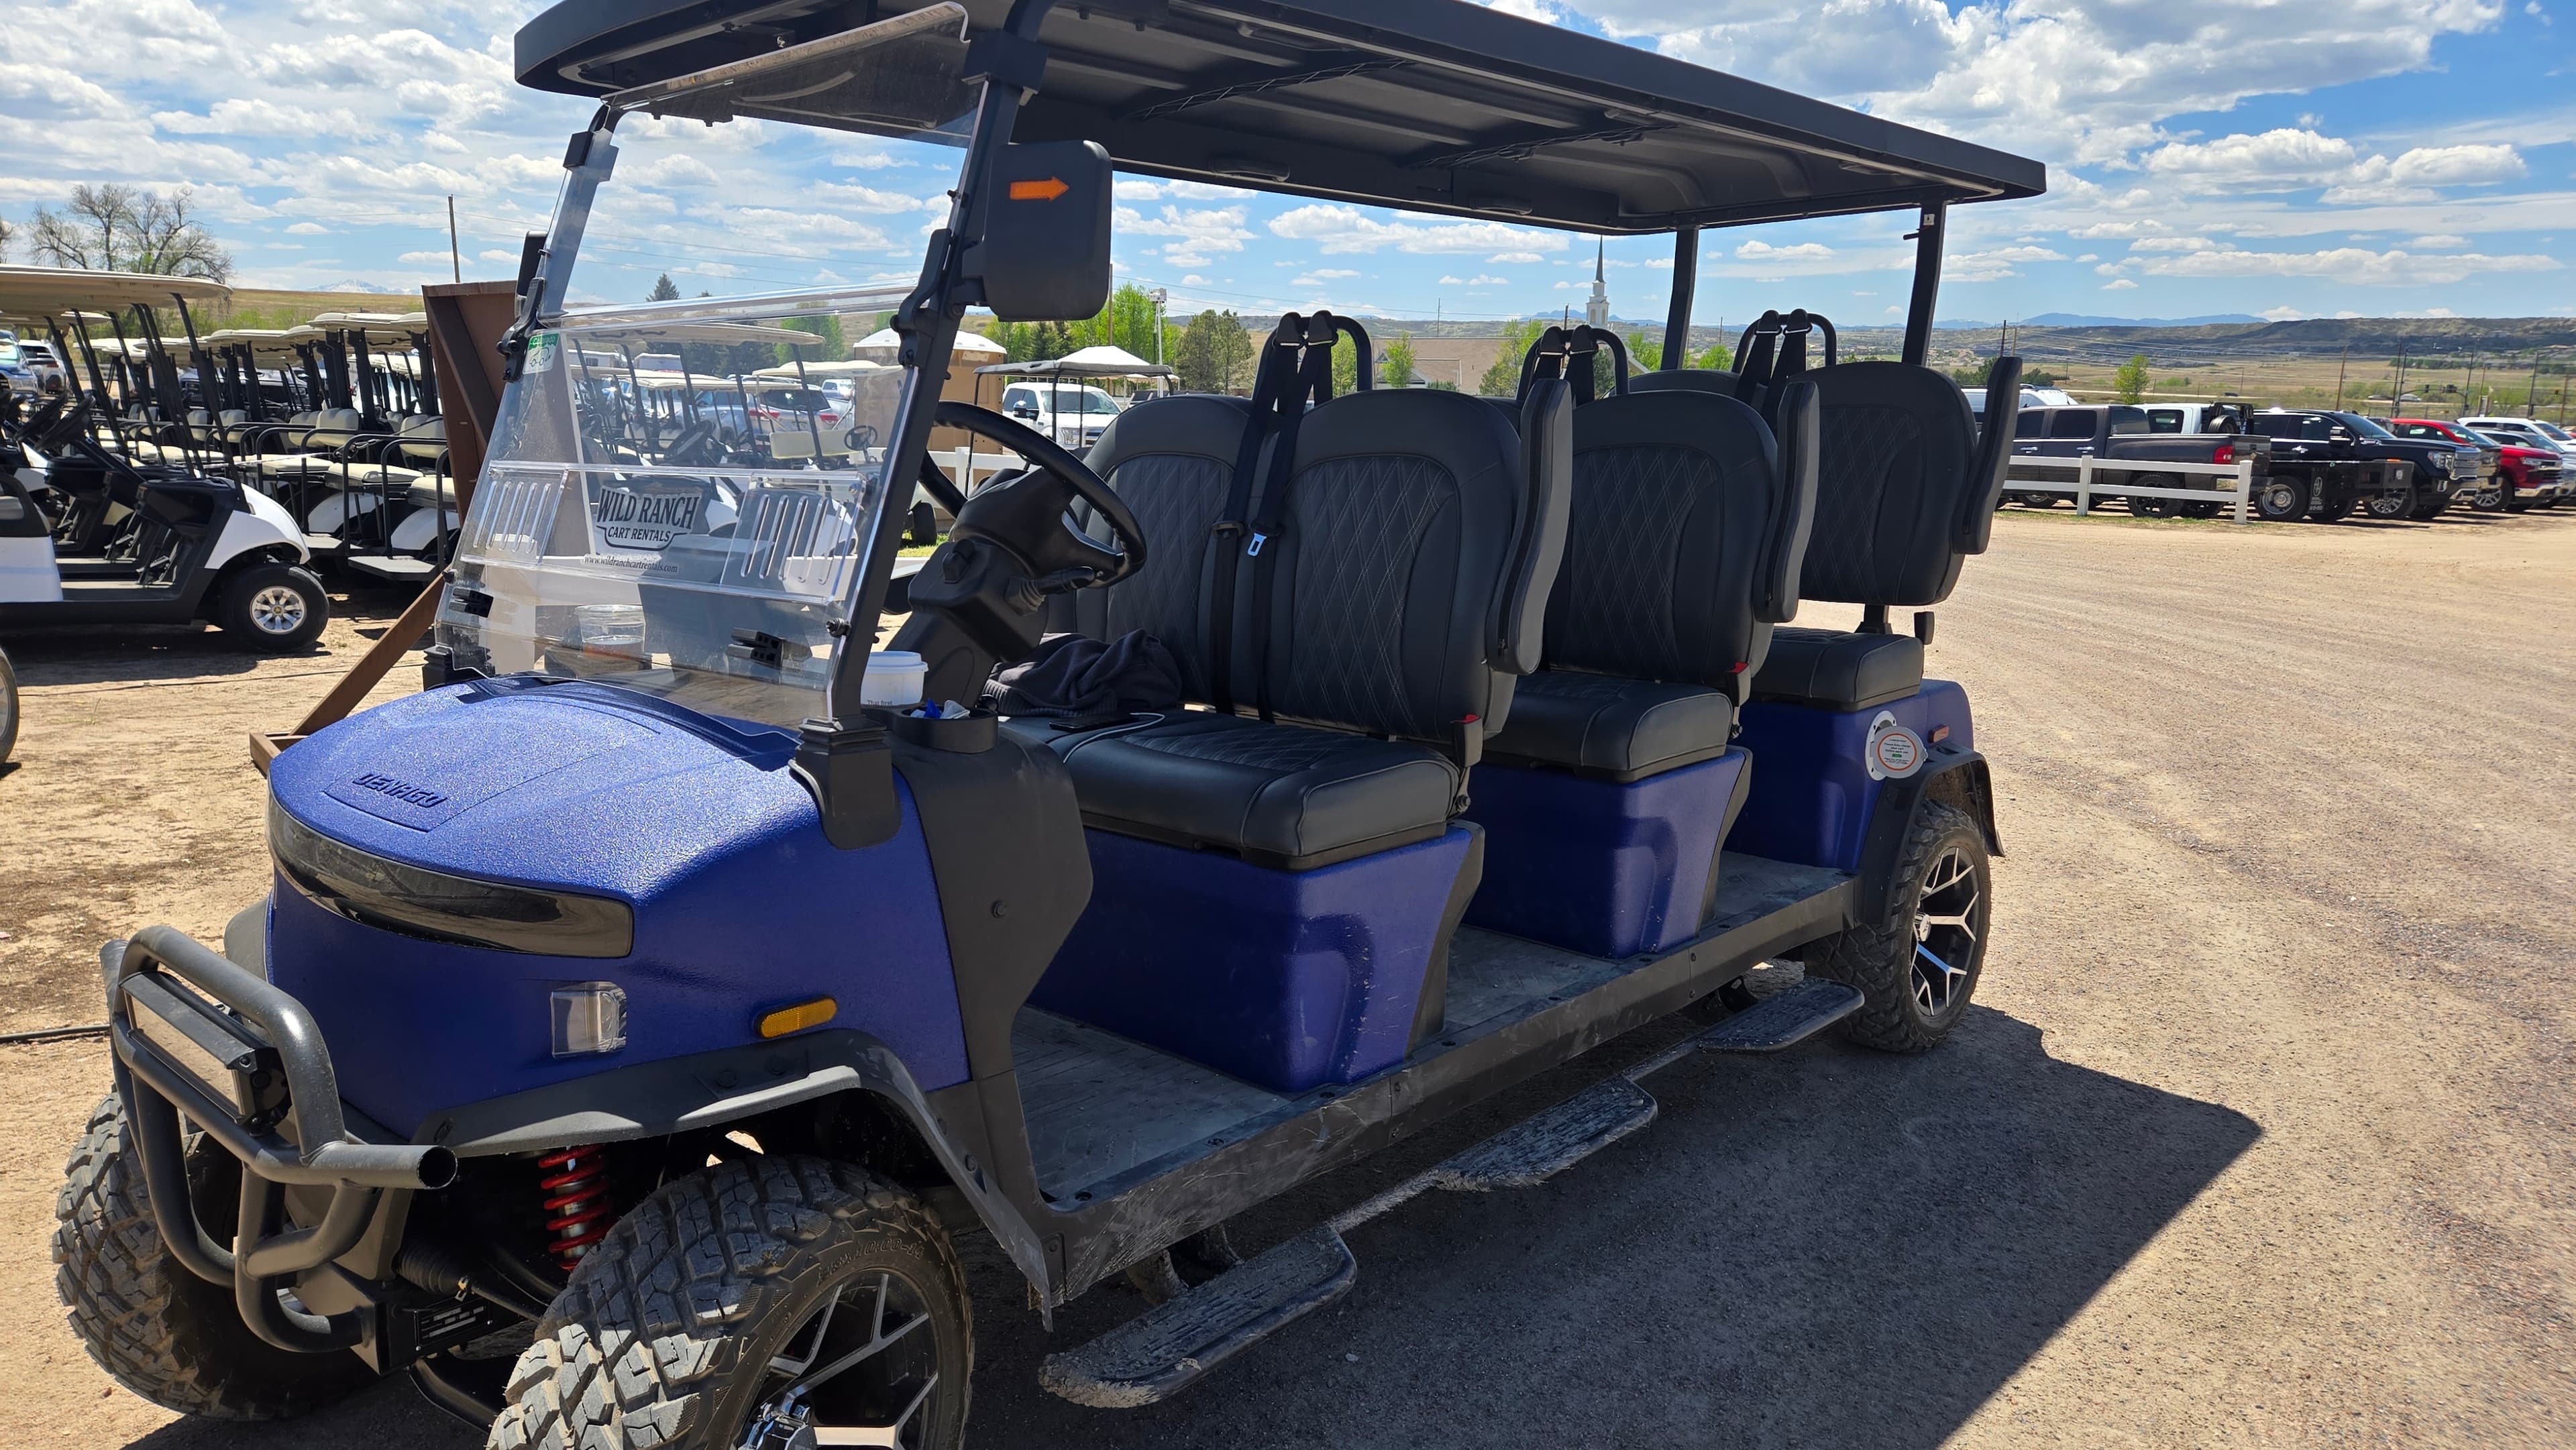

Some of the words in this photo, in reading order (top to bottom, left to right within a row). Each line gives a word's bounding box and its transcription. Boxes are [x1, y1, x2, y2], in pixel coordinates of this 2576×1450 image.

[596, 488, 637, 522] WILD
[638, 496, 700, 529] RANCH
[608, 526, 631, 539] CART
[631, 528, 671, 542] RENTALS
[584, 556, 678, 572] www.wildranchcartrentals.com
